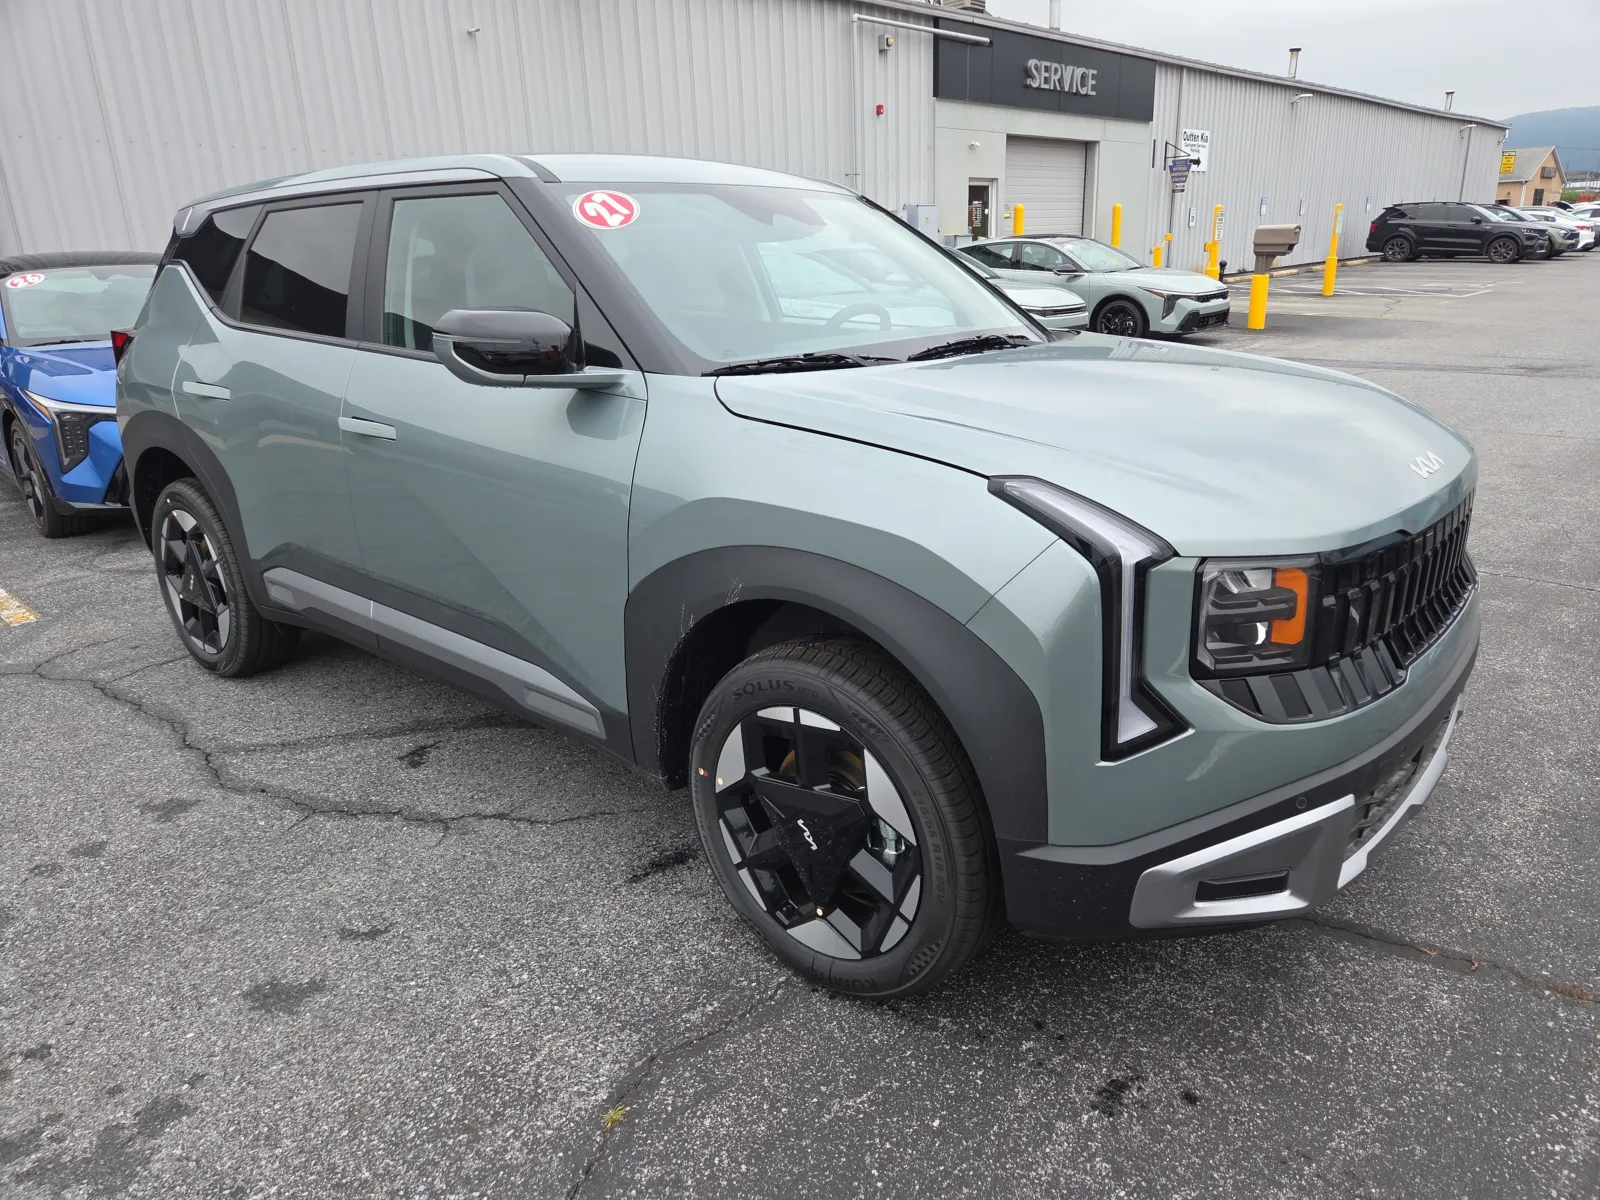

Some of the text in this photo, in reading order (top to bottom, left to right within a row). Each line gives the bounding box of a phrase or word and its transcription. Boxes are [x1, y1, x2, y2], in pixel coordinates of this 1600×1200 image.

[1026, 59, 1098, 96] SERVICE
[1183, 131, 1199, 142] Outten
[583, 192, 631, 227] 27
[10, 274, 42, 287] 26
[732, 679, 795, 701] SOLUS
